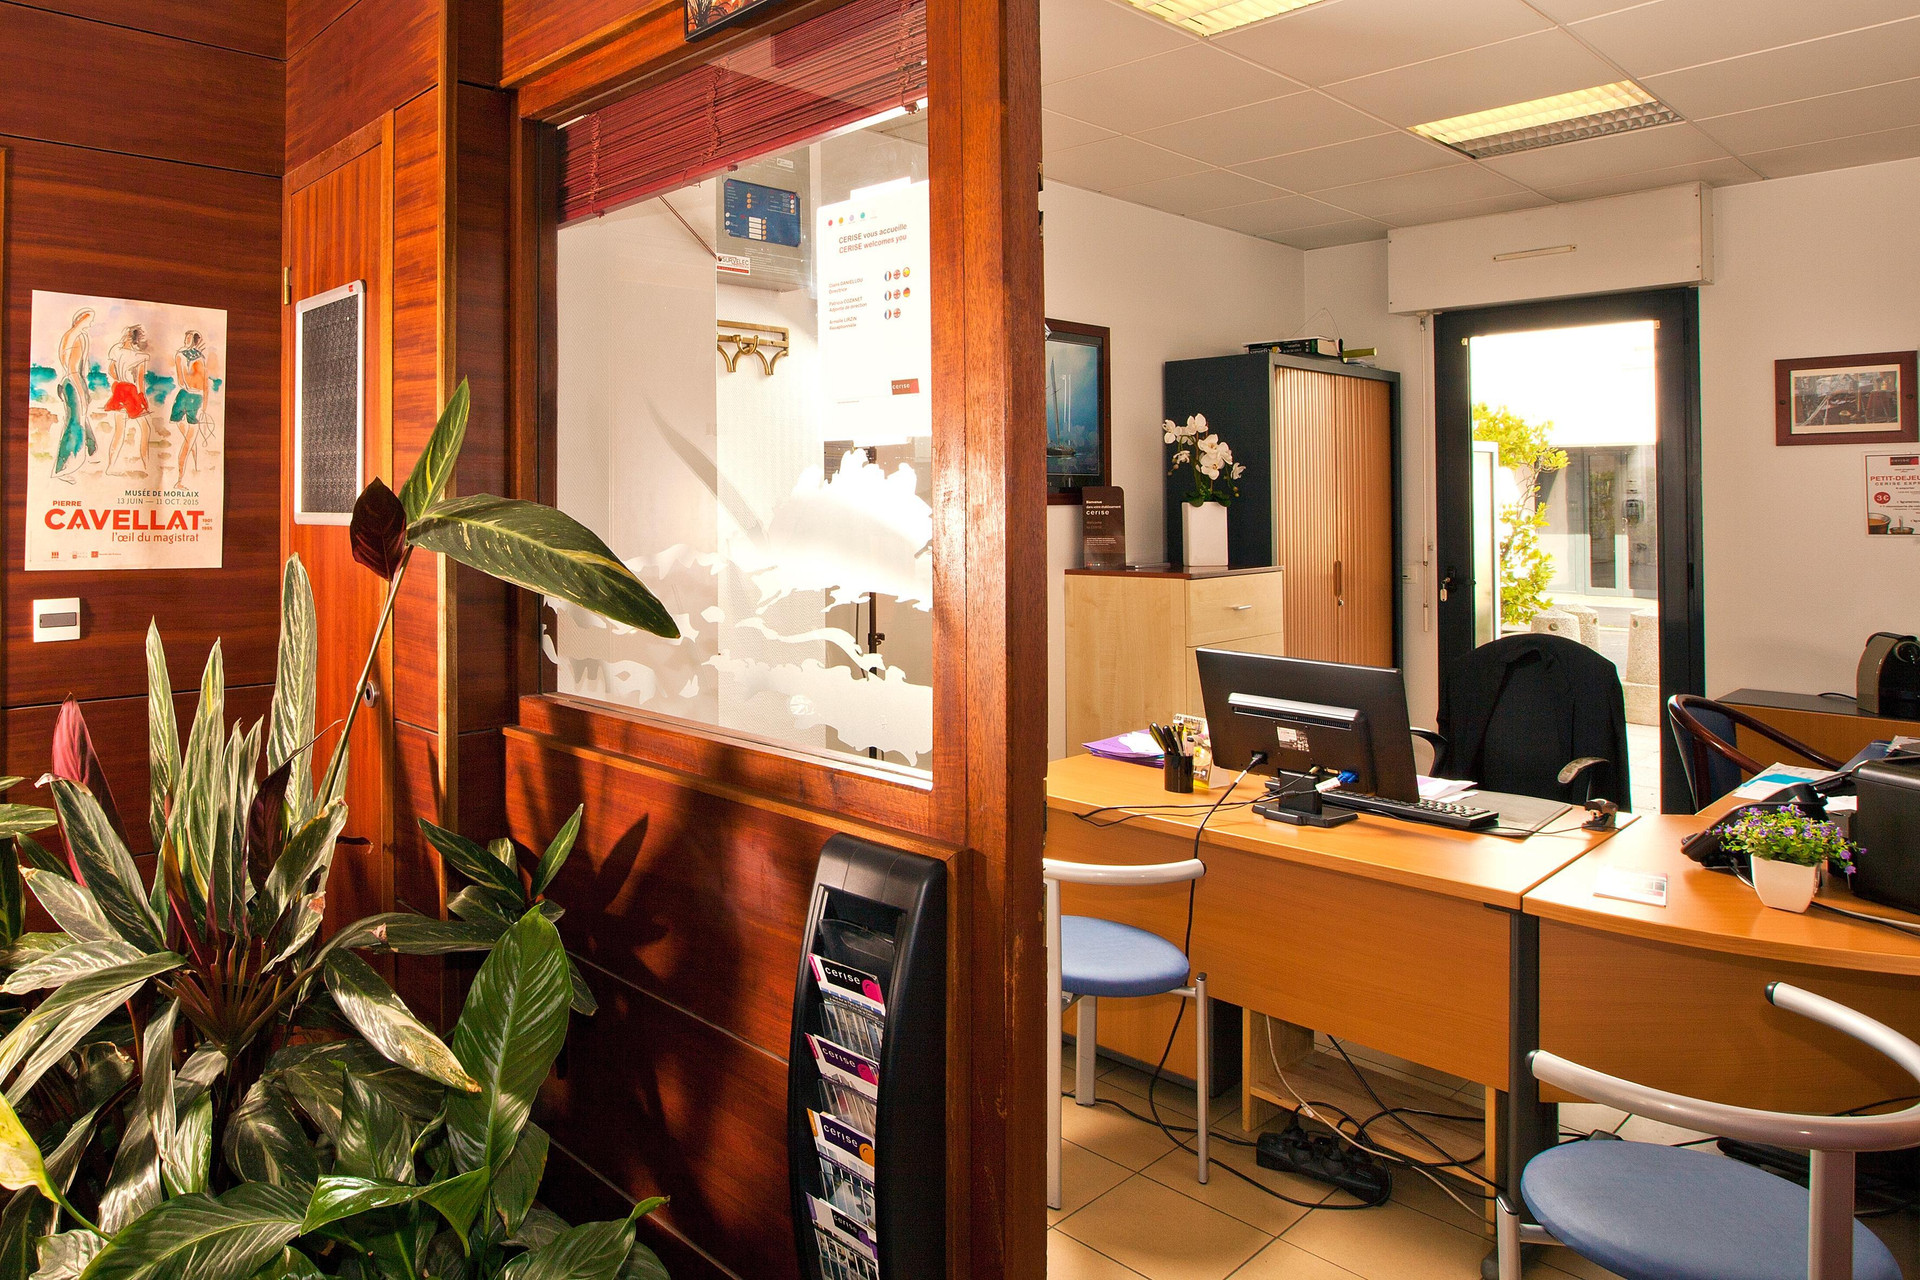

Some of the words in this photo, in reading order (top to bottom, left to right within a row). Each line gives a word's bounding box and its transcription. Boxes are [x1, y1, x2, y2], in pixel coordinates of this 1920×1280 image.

[838, 233, 862, 244] CERISE
[863, 230, 878, 239] vous
[878, 223, 908, 236] accueille
[838, 243, 862, 254] CERISE
[864, 237, 894, 249] welcomes
[896, 234, 907, 244] you
[44, 508, 204, 530] CAVELLAT
[112, 532, 134, 542] l'œil
[137, 532, 150, 542] du
[153, 532, 199, 544] magistrat
[824, 966, 861, 985] cerise
[822, 1046, 856, 1068] cerise
[823, 1124, 858, 1148] cerise
[833, 1213, 858, 1234] cerise
